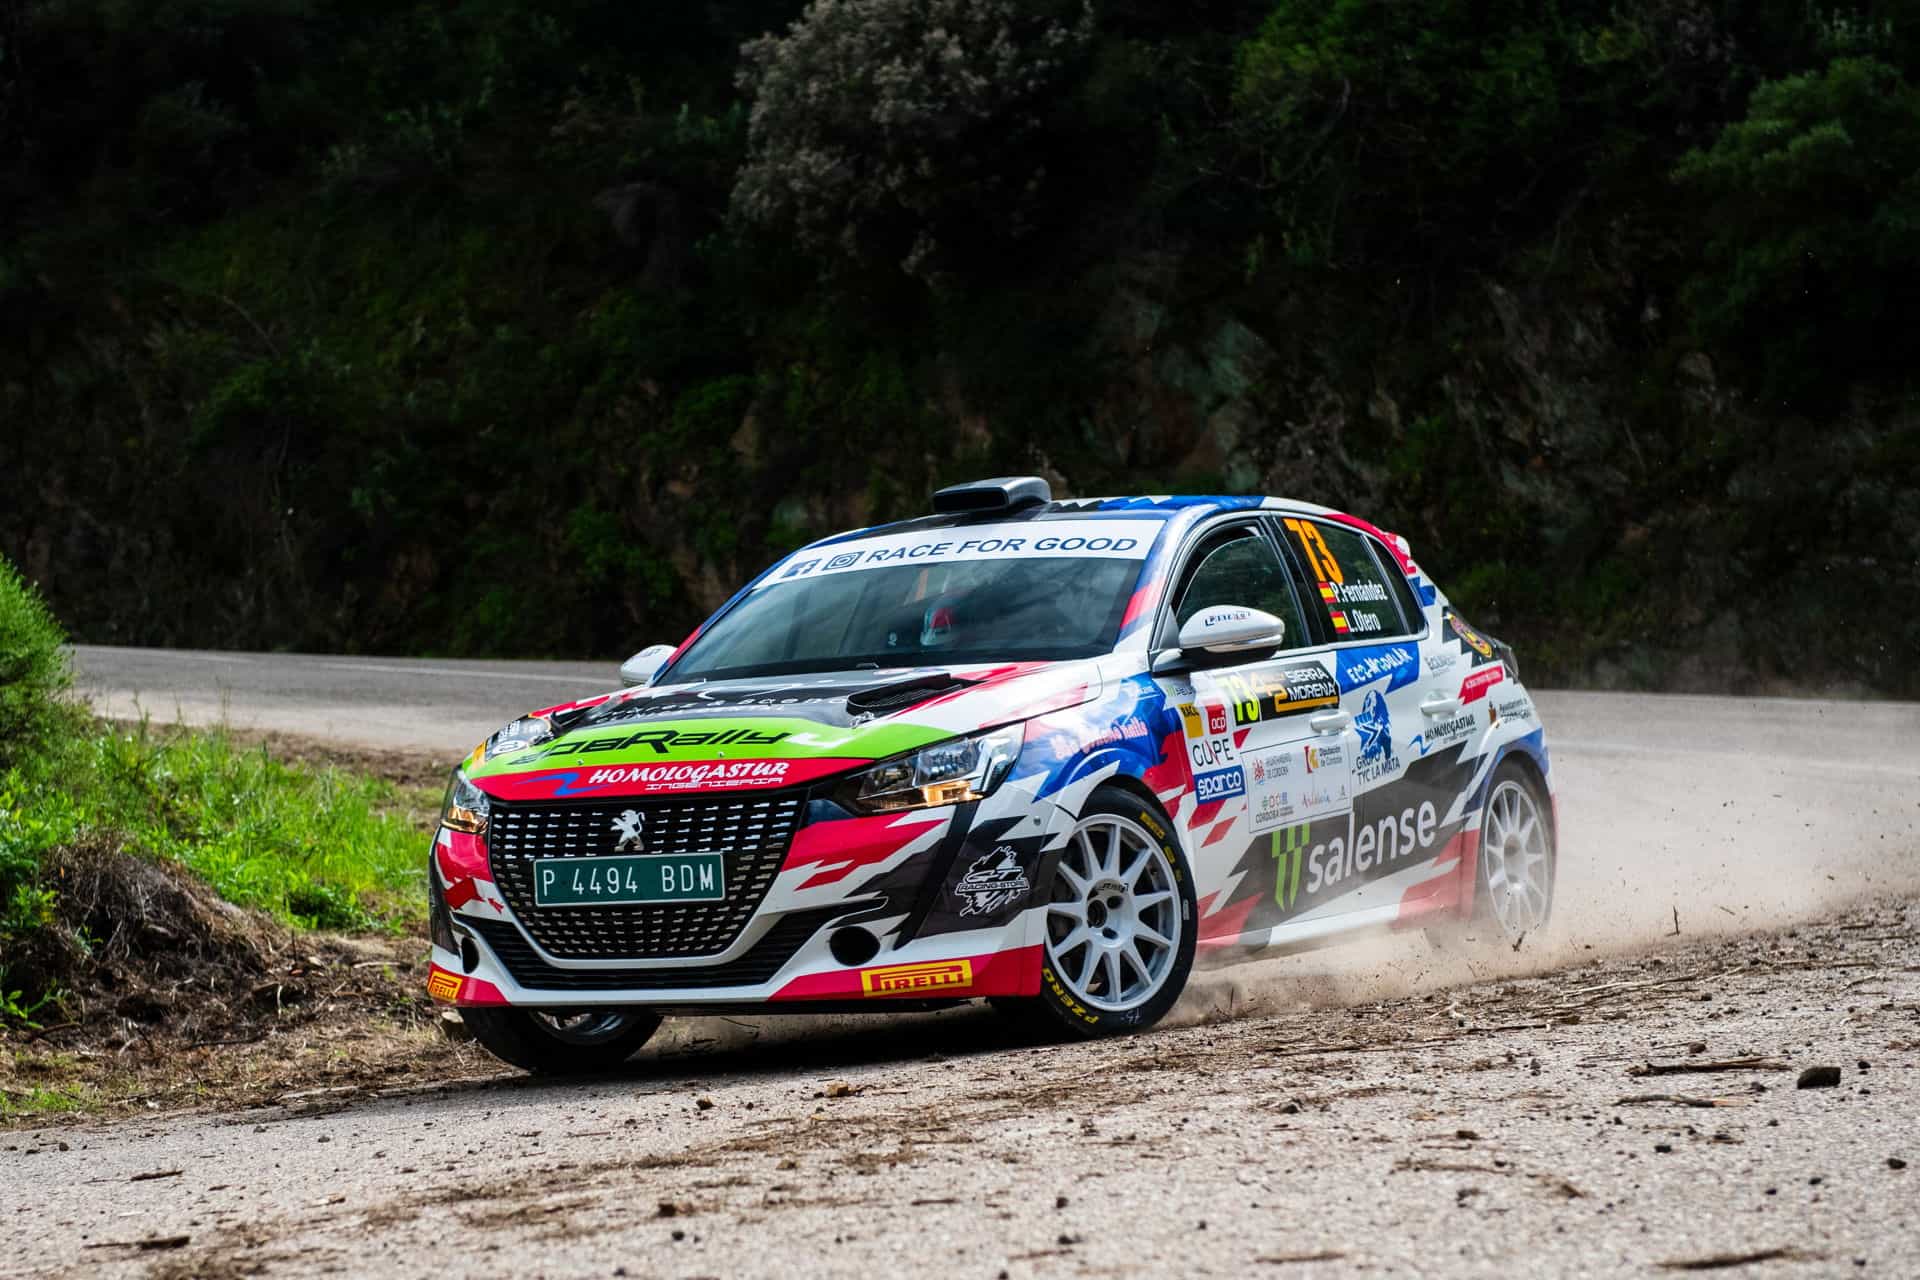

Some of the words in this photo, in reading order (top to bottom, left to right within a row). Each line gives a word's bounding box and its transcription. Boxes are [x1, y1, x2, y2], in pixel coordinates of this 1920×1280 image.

[866, 543, 953, 562] RACE
[957, 538, 1026, 554] FOR
[1034, 537, 1139, 552] GOOD
[1283, 518, 1344, 584] 73
[1285, 667, 1328, 684] SIERRA
[1287, 682, 1336, 702] MORENA
[588, 763, 790, 784] HOMOLOGASTUR
[1198, 772, 1242, 799] sparco
[1306, 801, 1437, 893] salense
[543, 870, 555, 896] P
[572, 866, 638, 895] 4494
[661, 863, 714, 892] BDM
[959, 882, 998, 891] RACING
[870, 965, 964, 992] PIRELLI
